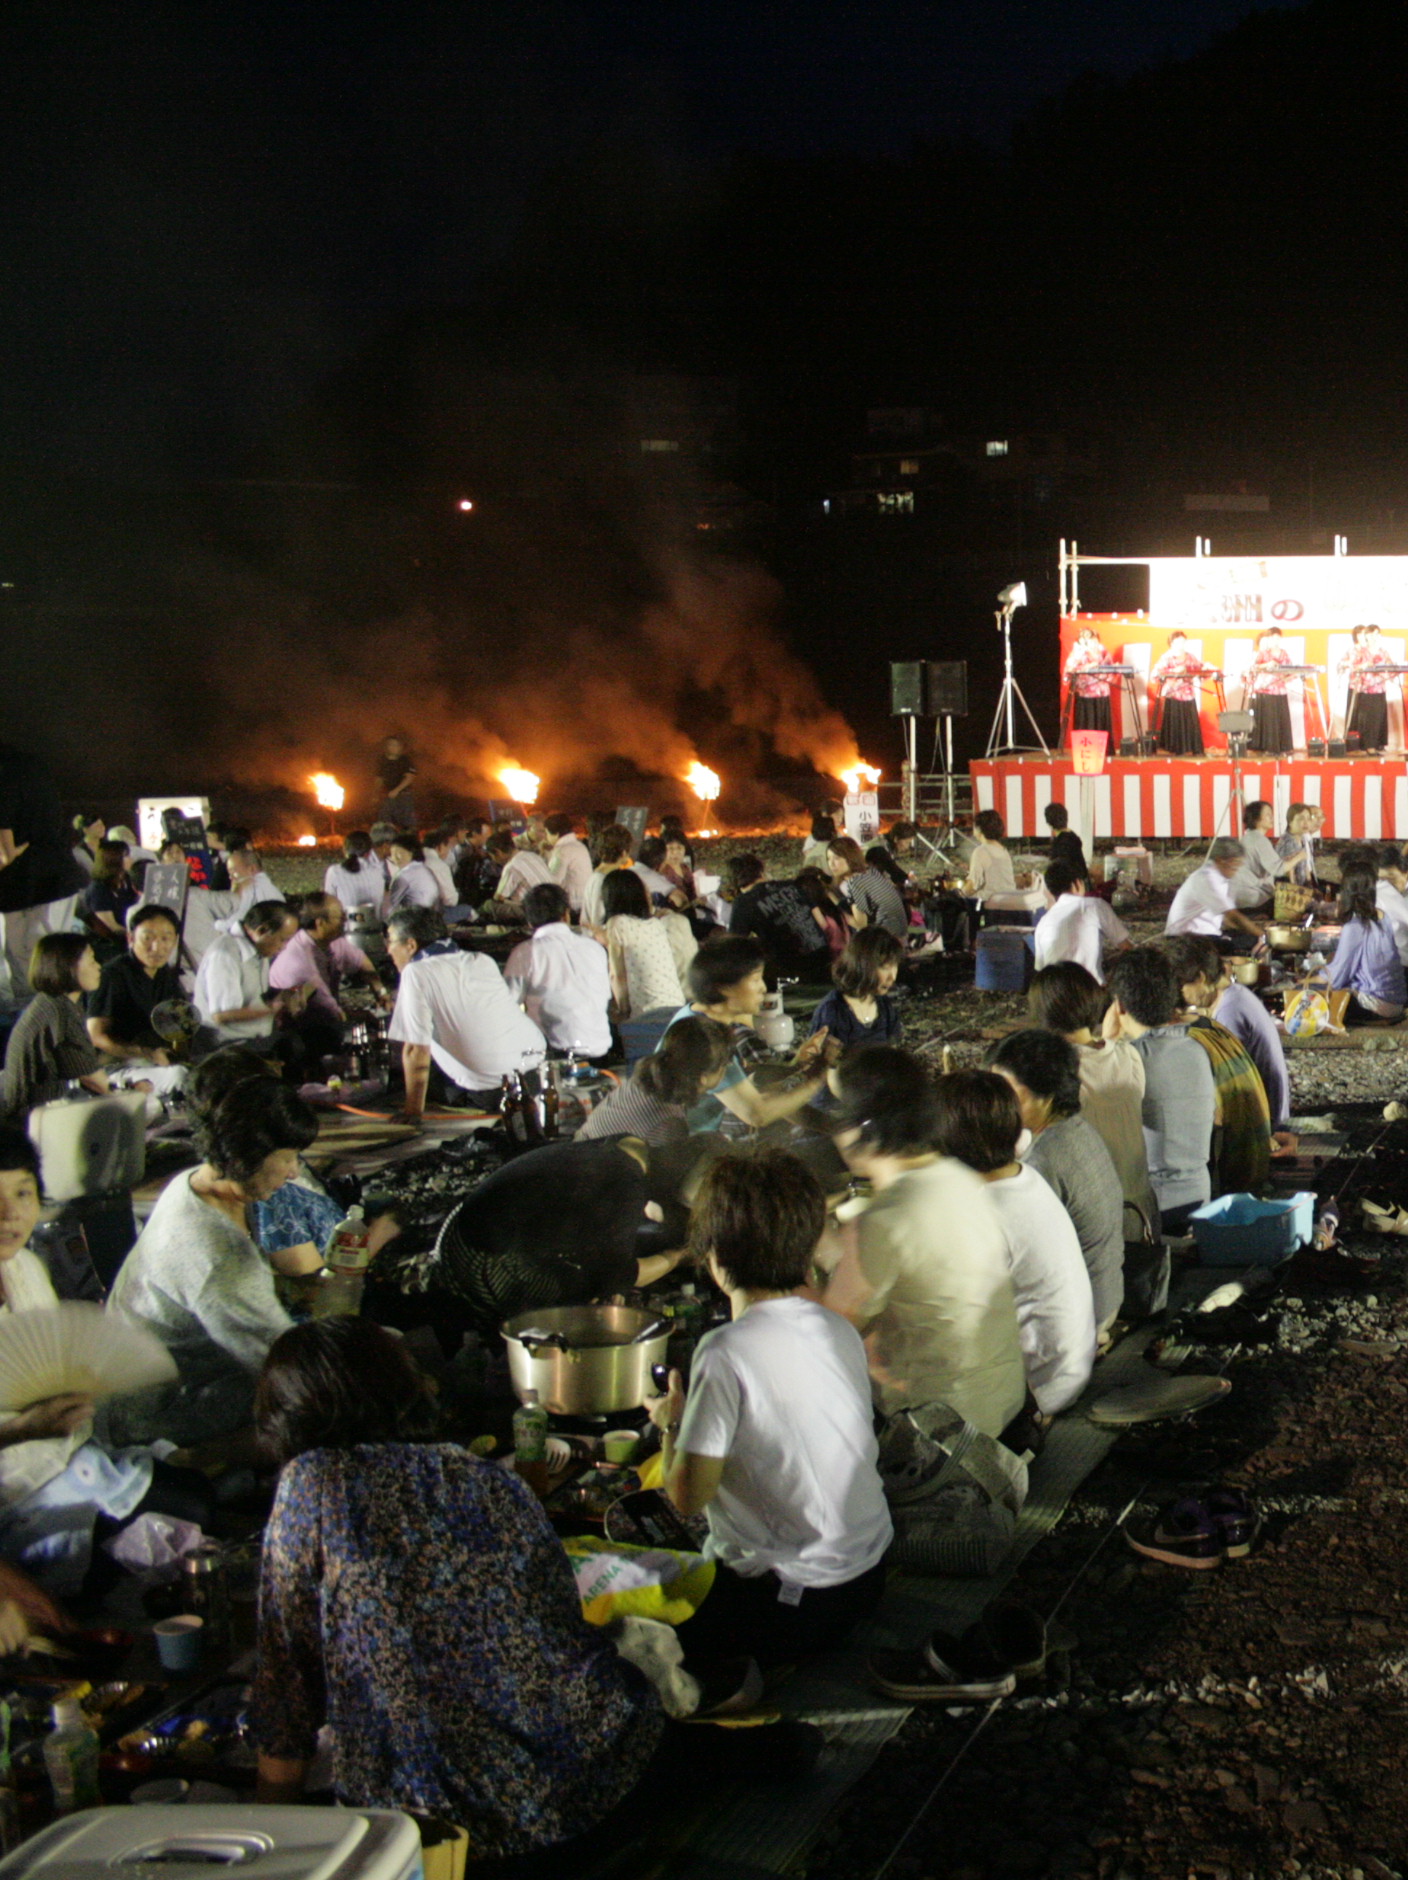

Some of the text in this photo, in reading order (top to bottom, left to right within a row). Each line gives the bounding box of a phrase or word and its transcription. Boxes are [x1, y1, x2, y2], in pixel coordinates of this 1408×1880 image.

[1079, 735, 1093, 773] 小にし
[583, 1563, 624, 1607] ARENA
